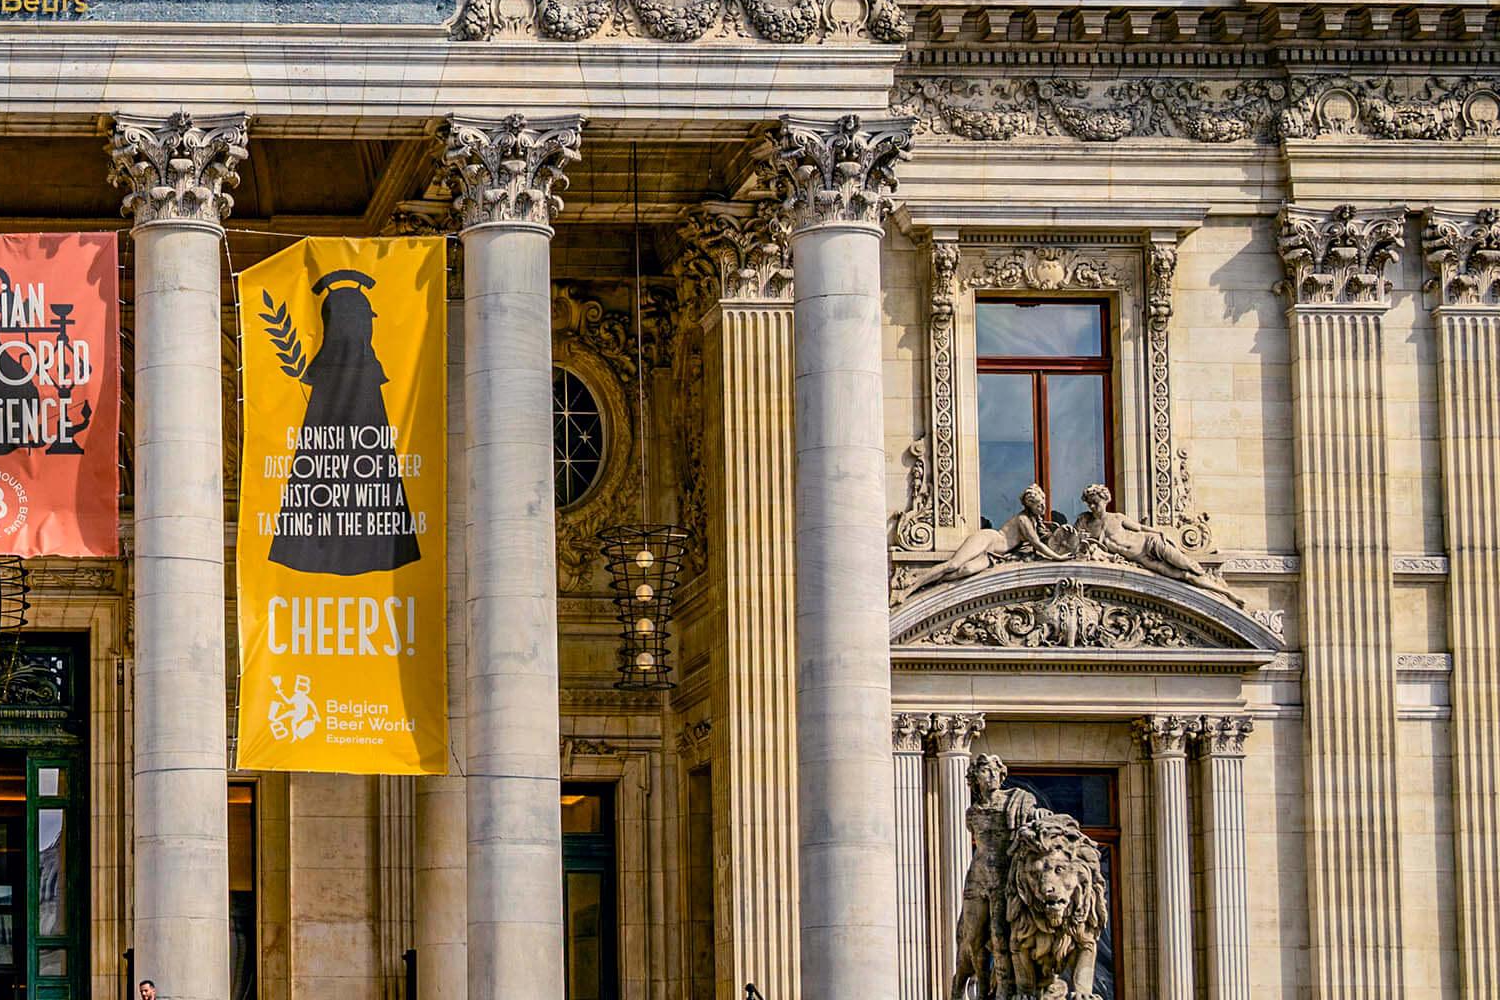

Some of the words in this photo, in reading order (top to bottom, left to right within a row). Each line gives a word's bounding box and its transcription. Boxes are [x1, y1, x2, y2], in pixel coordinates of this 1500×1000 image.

[350, 425, 398, 450] YOUR
[353, 455, 383, 478] OF
[388, 454, 421, 478] BEER
[395, 483, 404, 506] A
[336, 512, 362, 536] THE
[367, 511, 427, 536] BEERLAB
[268, 595, 415, 656] CHEERS!
[326, 699, 389, 718] Belgian
[326, 716, 364, 730] Beer
[368, 717, 416, 732] World
[326, 733, 384, 745] Experience
